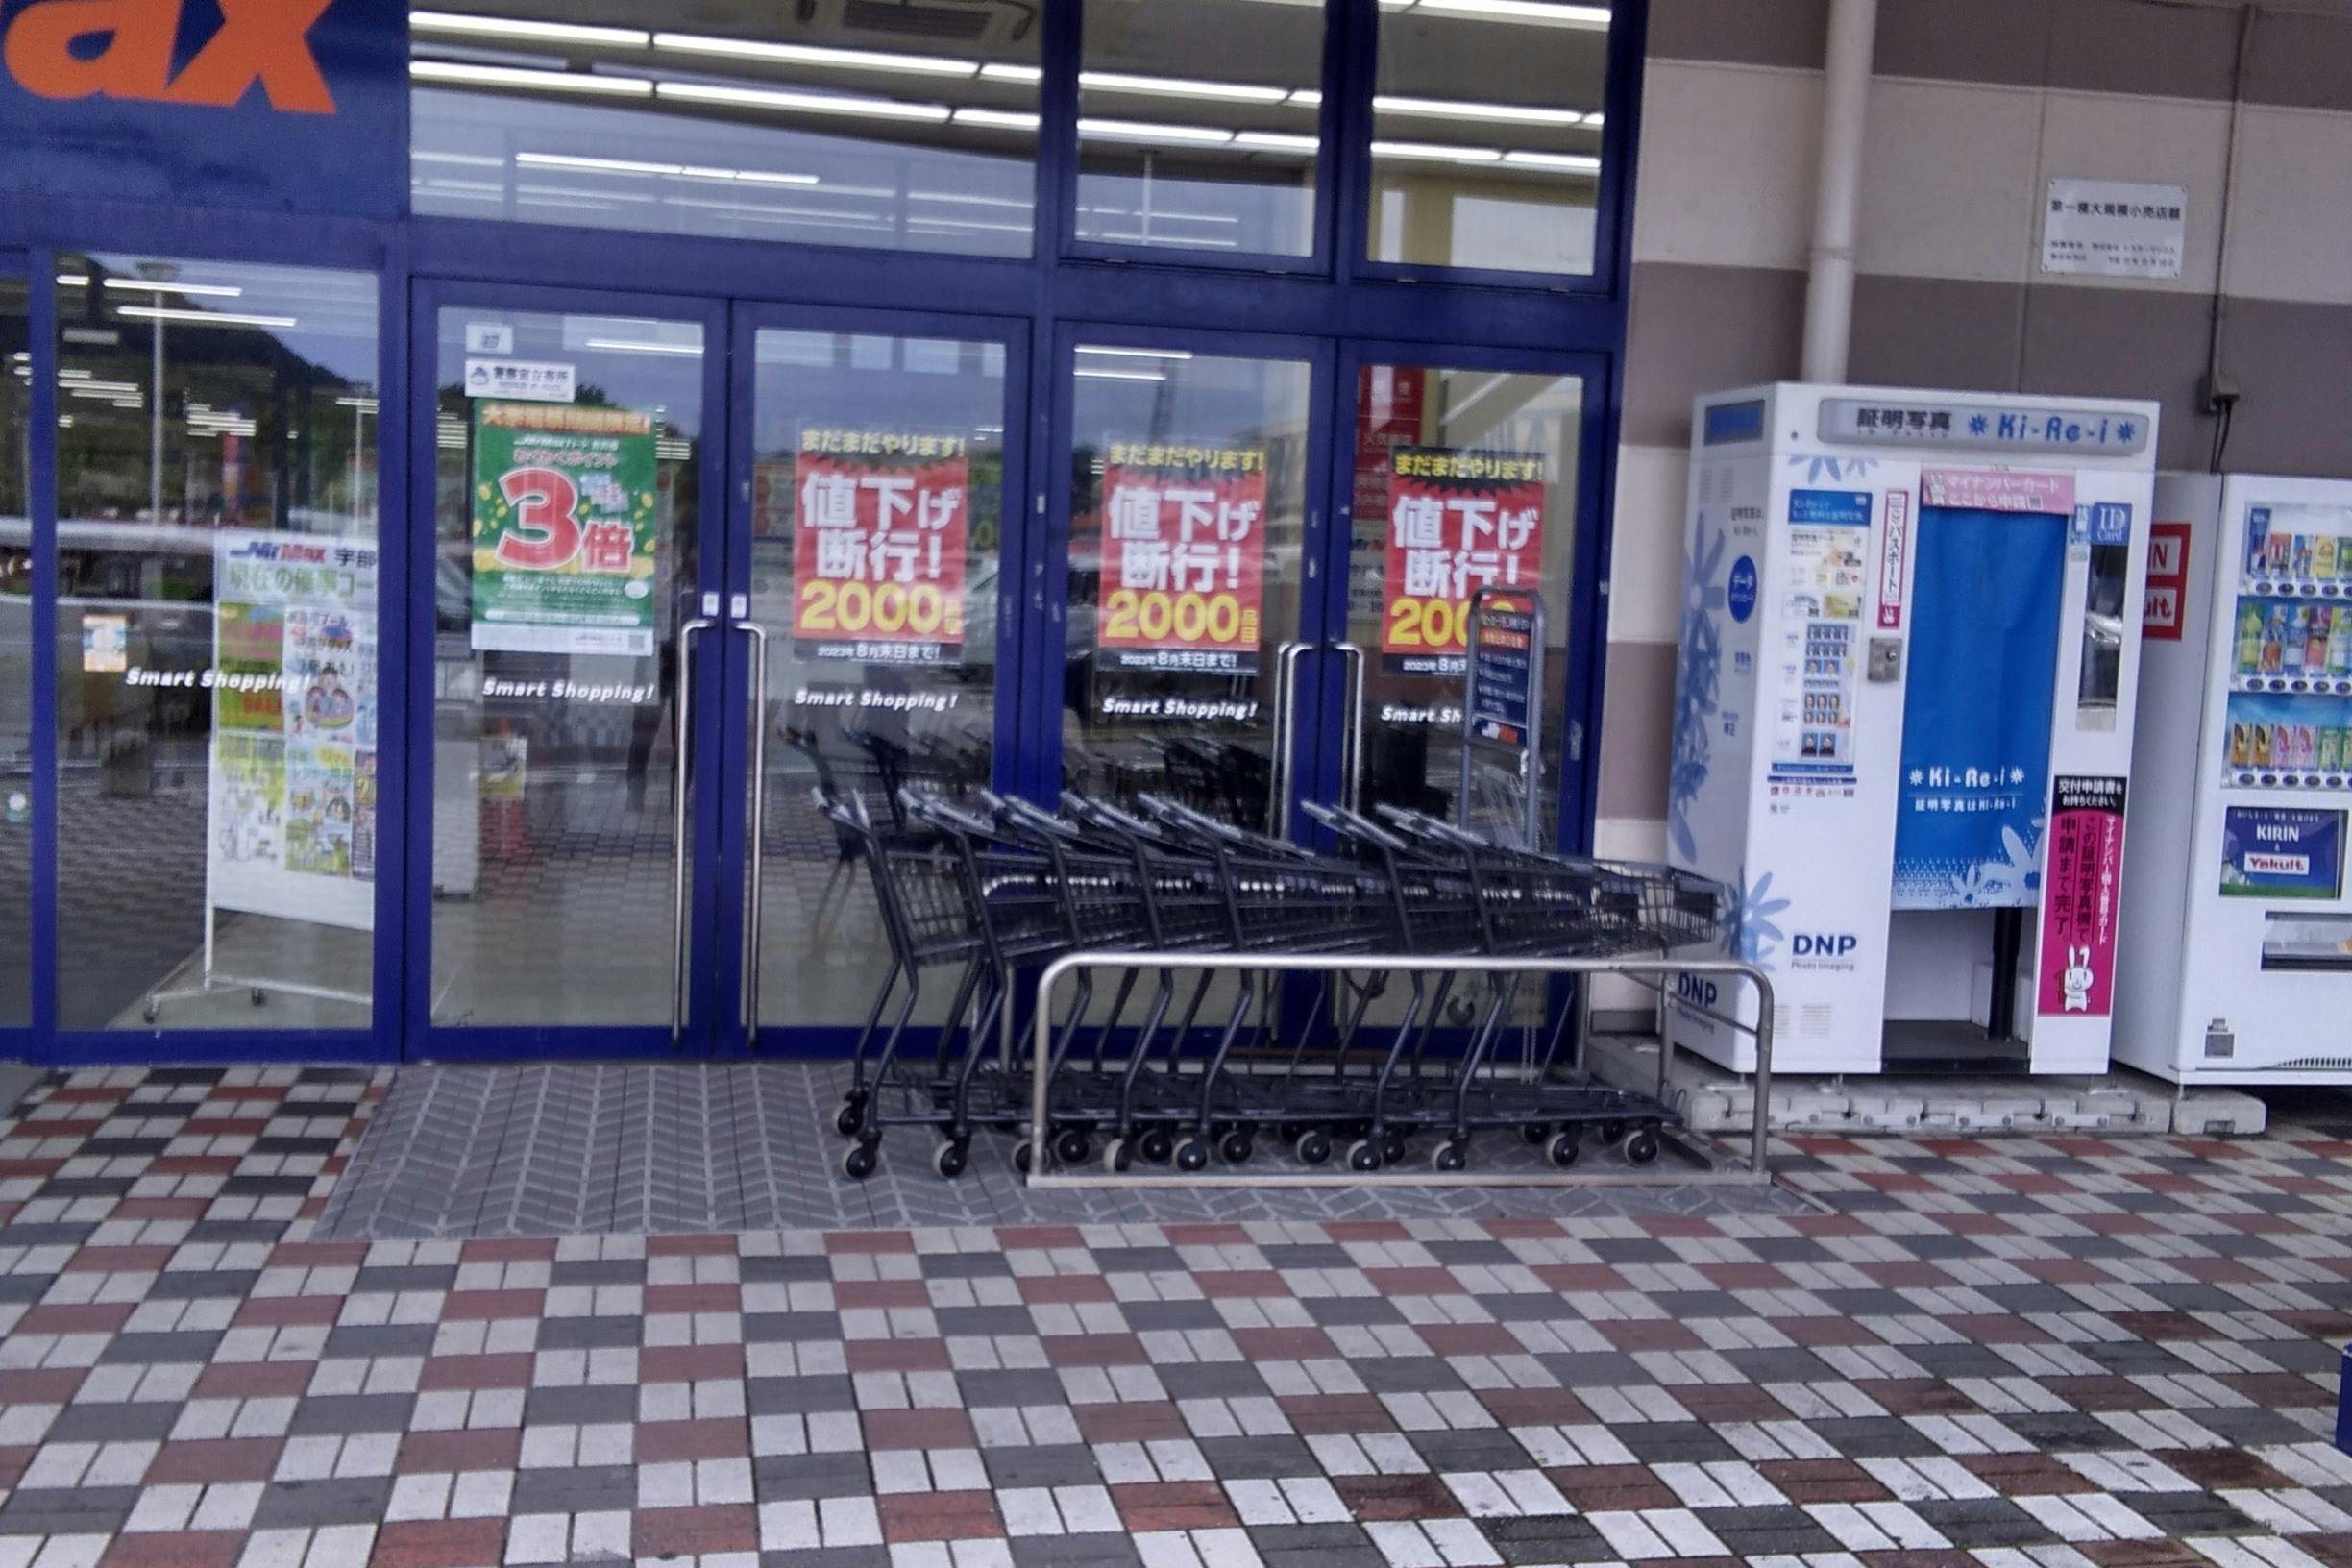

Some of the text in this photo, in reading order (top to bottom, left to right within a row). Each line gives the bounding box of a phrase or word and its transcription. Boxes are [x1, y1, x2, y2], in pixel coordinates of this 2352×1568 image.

[802, 473, 961, 531] 値下げ
[1108, 485, 1261, 542] 値下げ
[1394, 495, 1539, 551] 値下げ
[125, 667, 312, 695] Smart Shopping!
[482, 677, 654, 703] Smart Shopping!
[795, 687, 959, 712] Smart Shopping!
[1102, 697, 1258, 721] Smart Shopping!
[1381, 706, 1433, 723] Smart
[2256, 824, 2299, 843] KIRIN
[2249, 856, 2305, 871] Yakult
[1793, 934, 1856, 957] DNP
[1678, 971, 1717, 1009] DNP
